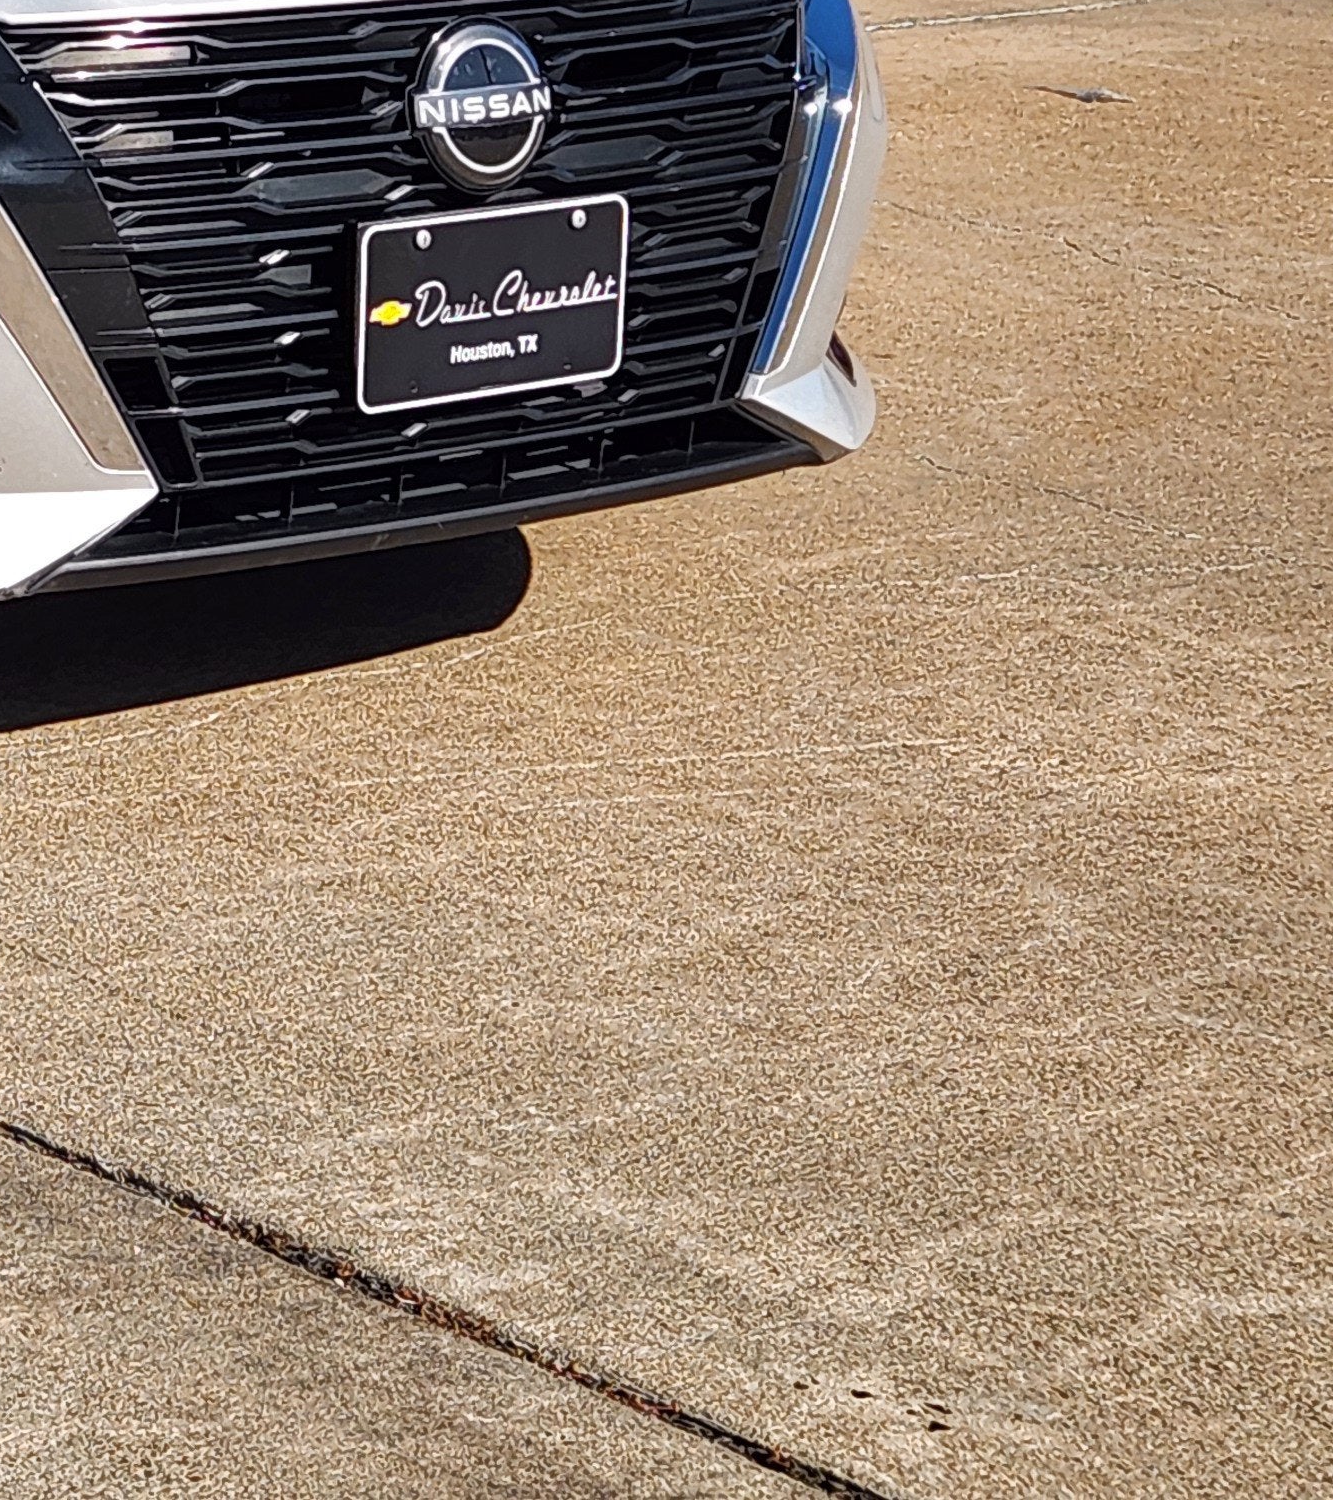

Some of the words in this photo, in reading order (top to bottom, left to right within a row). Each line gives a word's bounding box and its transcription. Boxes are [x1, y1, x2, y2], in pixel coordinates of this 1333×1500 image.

[418, 86, 552, 125] NISSAN
[415, 279, 492, 327] Davis
[492, 269, 618, 318] Chevrolet
[450, 340, 515, 364] Houston,
[518, 334, 539, 354] TX
